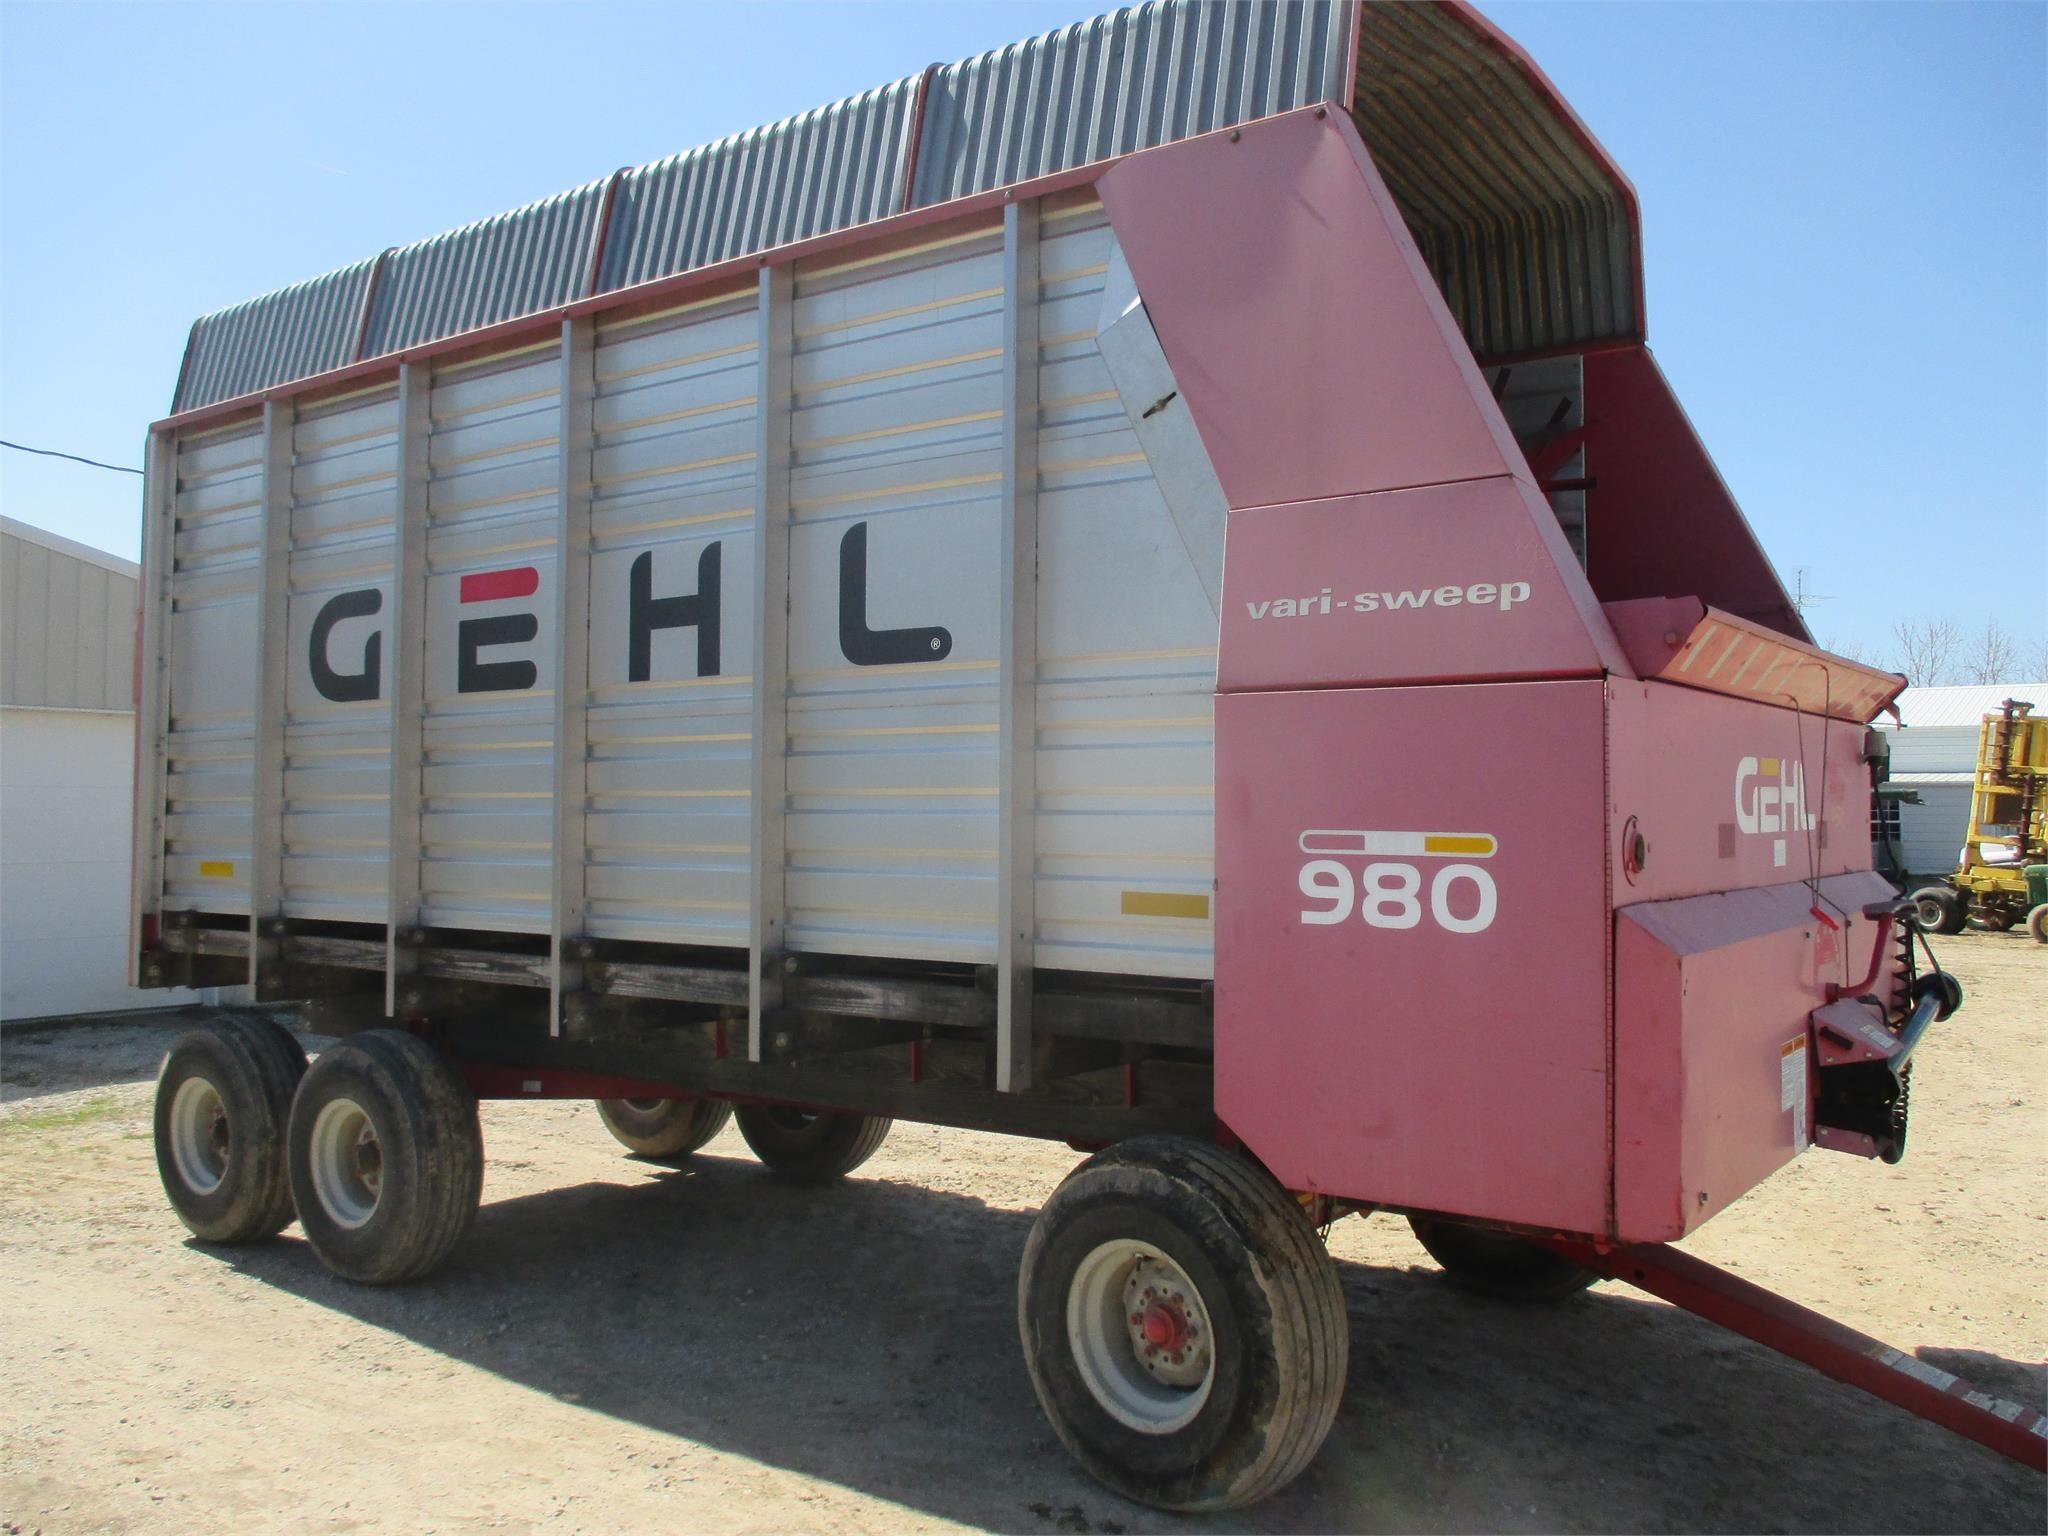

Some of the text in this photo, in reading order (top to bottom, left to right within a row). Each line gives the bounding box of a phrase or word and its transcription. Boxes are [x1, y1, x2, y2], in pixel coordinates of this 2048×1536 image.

[309, 521, 952, 702] GEHL
[1246, 581, 1531, 620] vari-sweep
[1735, 756, 1816, 834] GEHL
[1299, 859, 1498, 934] 980
